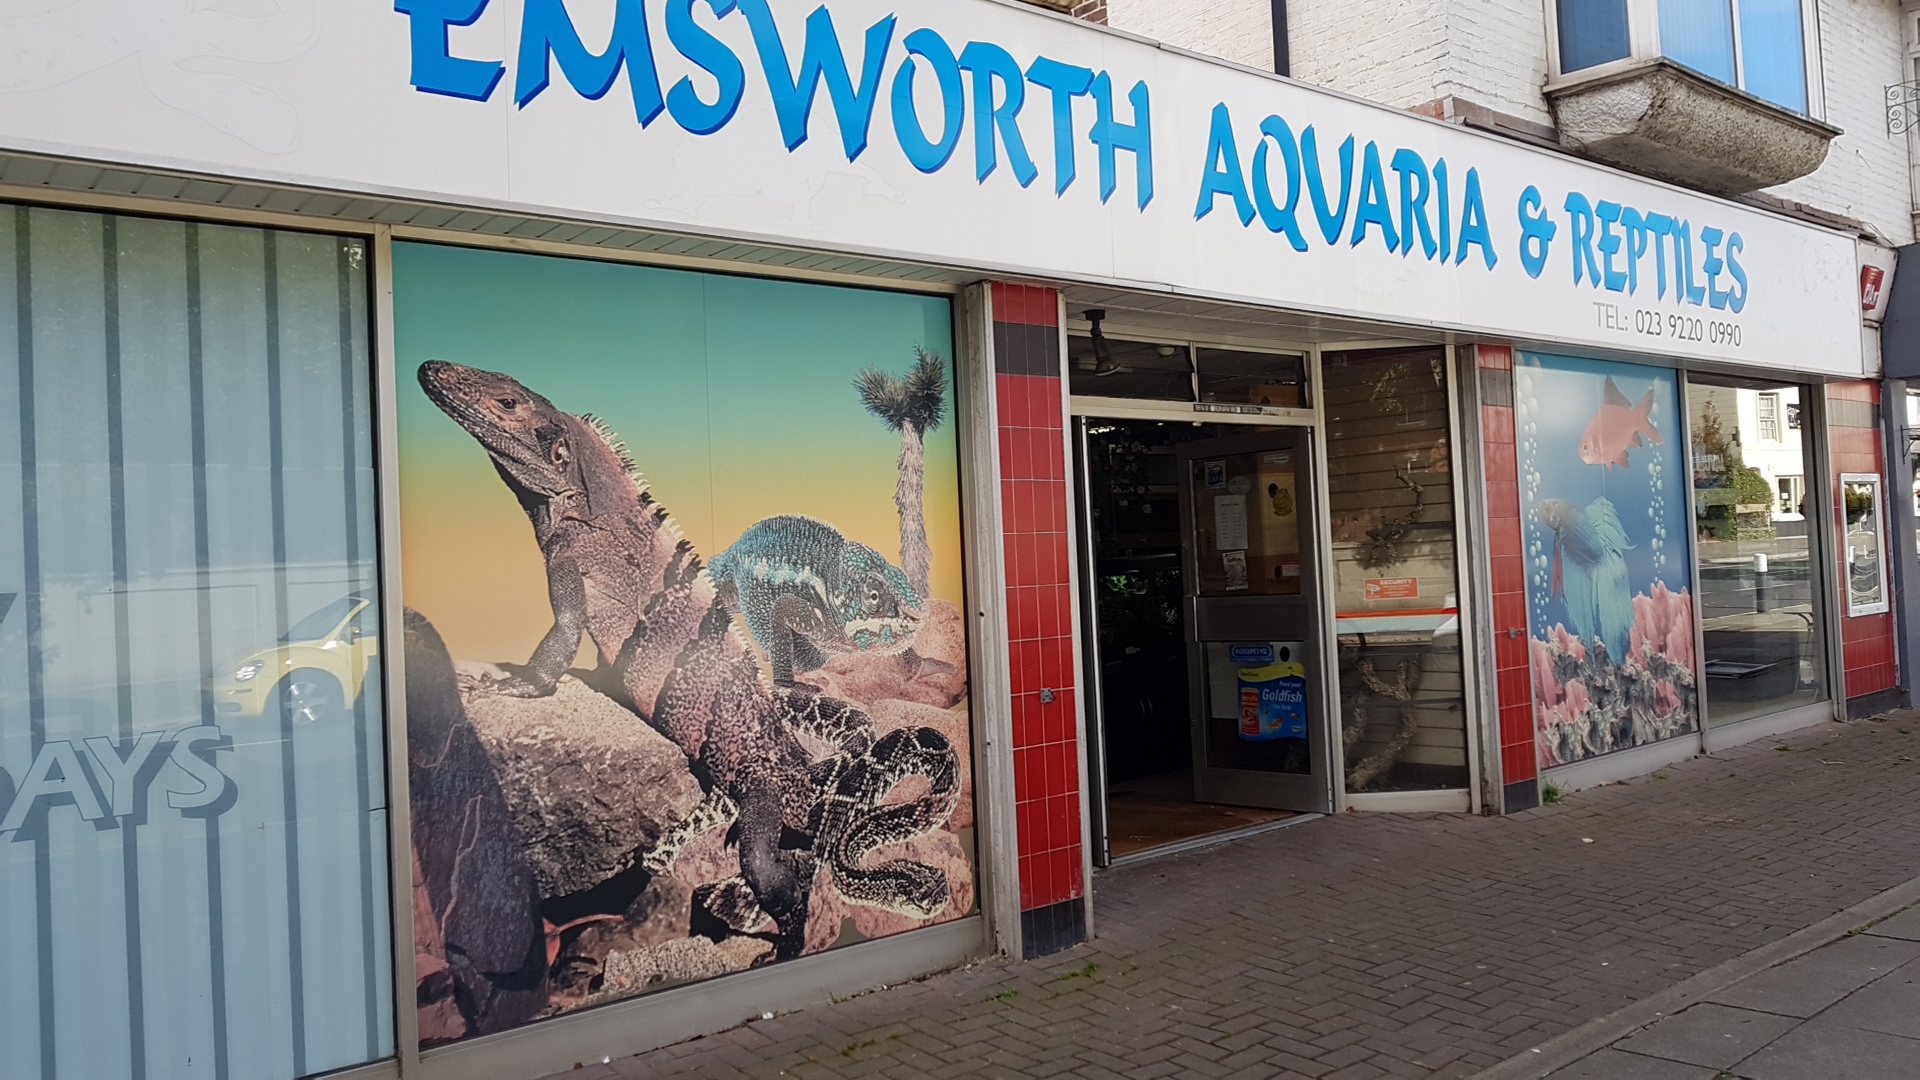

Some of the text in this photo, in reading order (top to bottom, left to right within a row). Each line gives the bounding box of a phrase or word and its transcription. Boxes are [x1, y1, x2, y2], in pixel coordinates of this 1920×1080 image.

[394, 0, 1748, 314] EMSWORTH AQUARIA & REPTILES
[1593, 301, 1742, 347] TEL: 023 9220 0990
[1262, 688, 1302, 703] Goldfish
[0, 725, 239, 842] AYS
